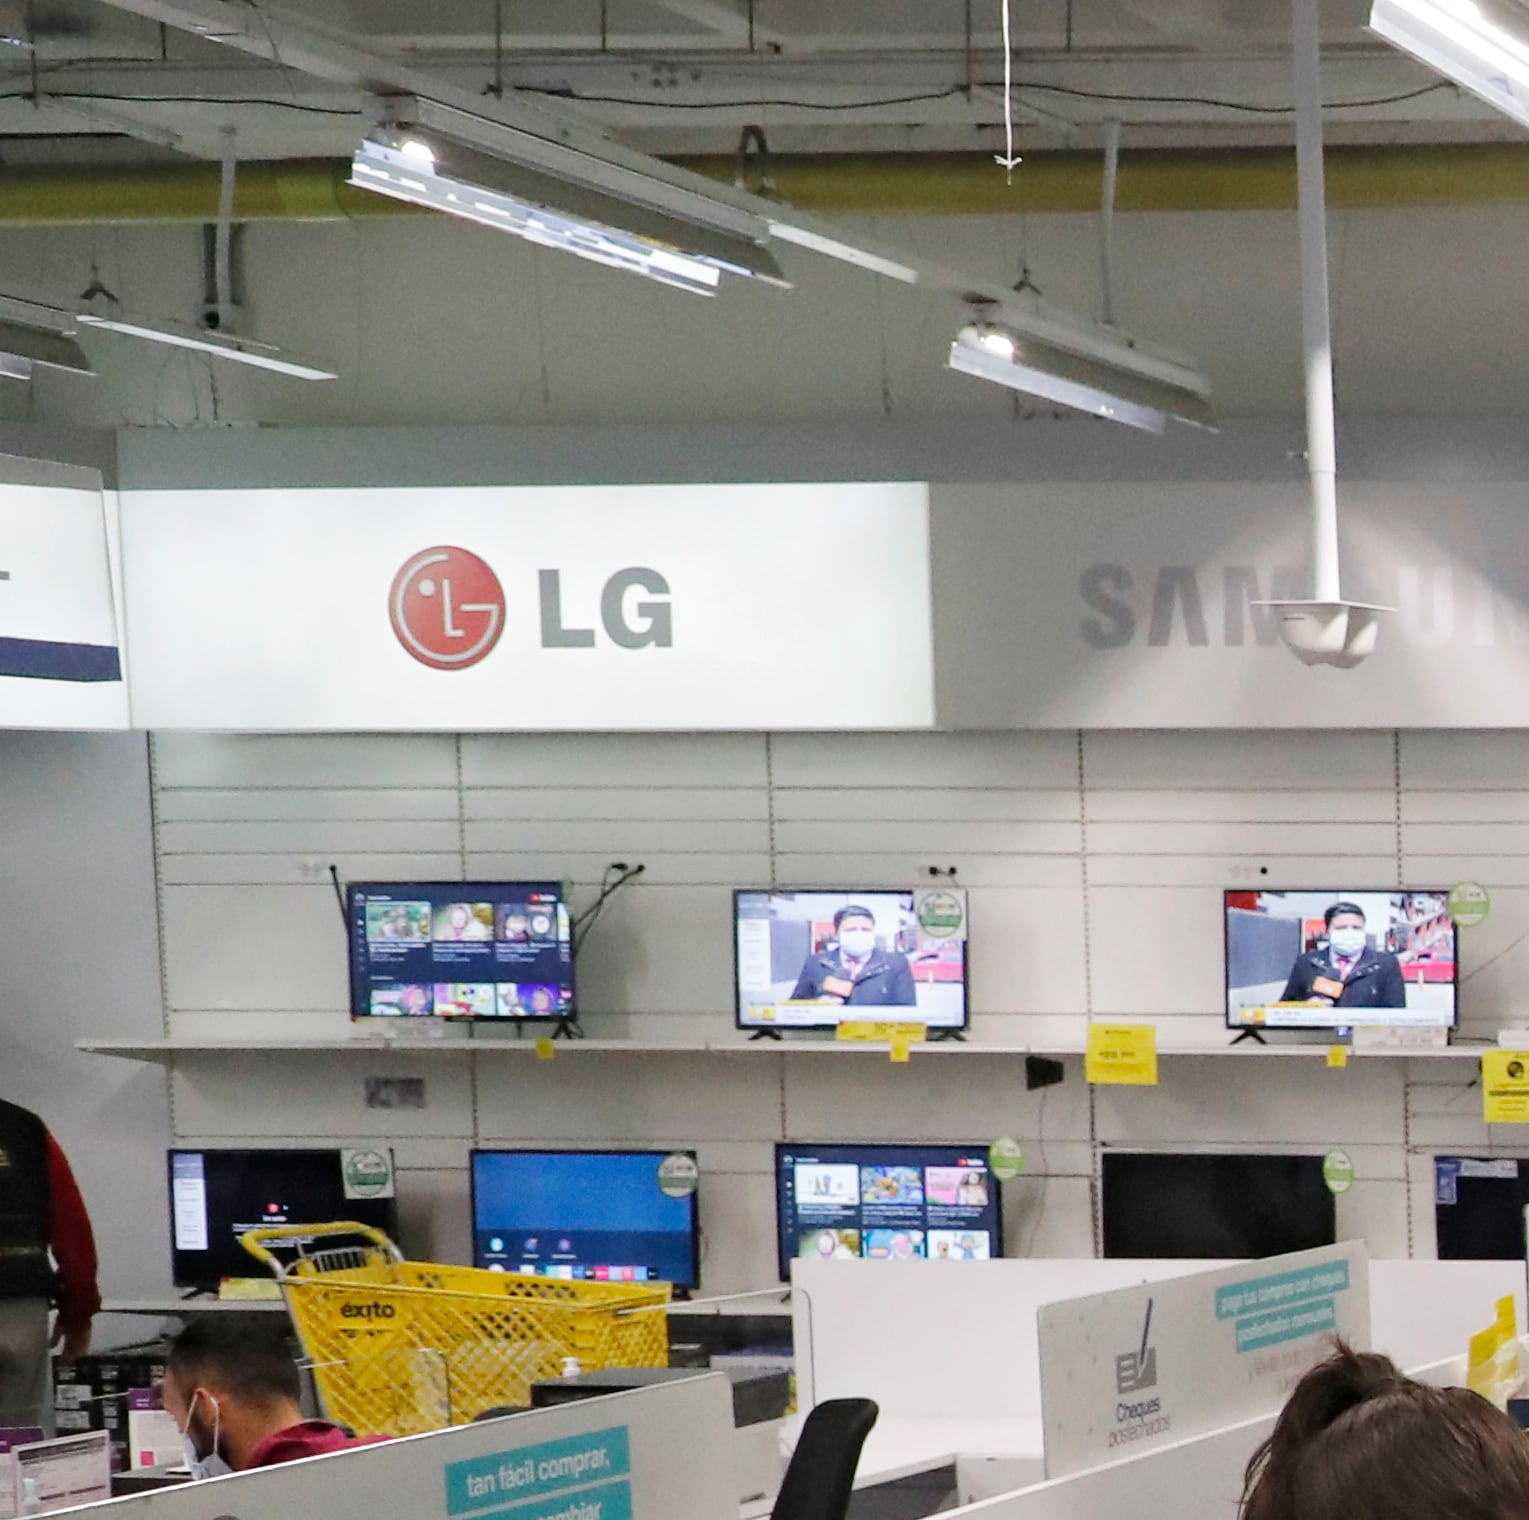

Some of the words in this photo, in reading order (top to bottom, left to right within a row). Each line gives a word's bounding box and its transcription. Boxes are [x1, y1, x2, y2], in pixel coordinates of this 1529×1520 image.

[539, 567, 674, 649] LG
[466, 1472, 496, 1498] tan
[499, 1459, 535, 1490] fácil
[538, 1447, 611, 1480] comprar,
